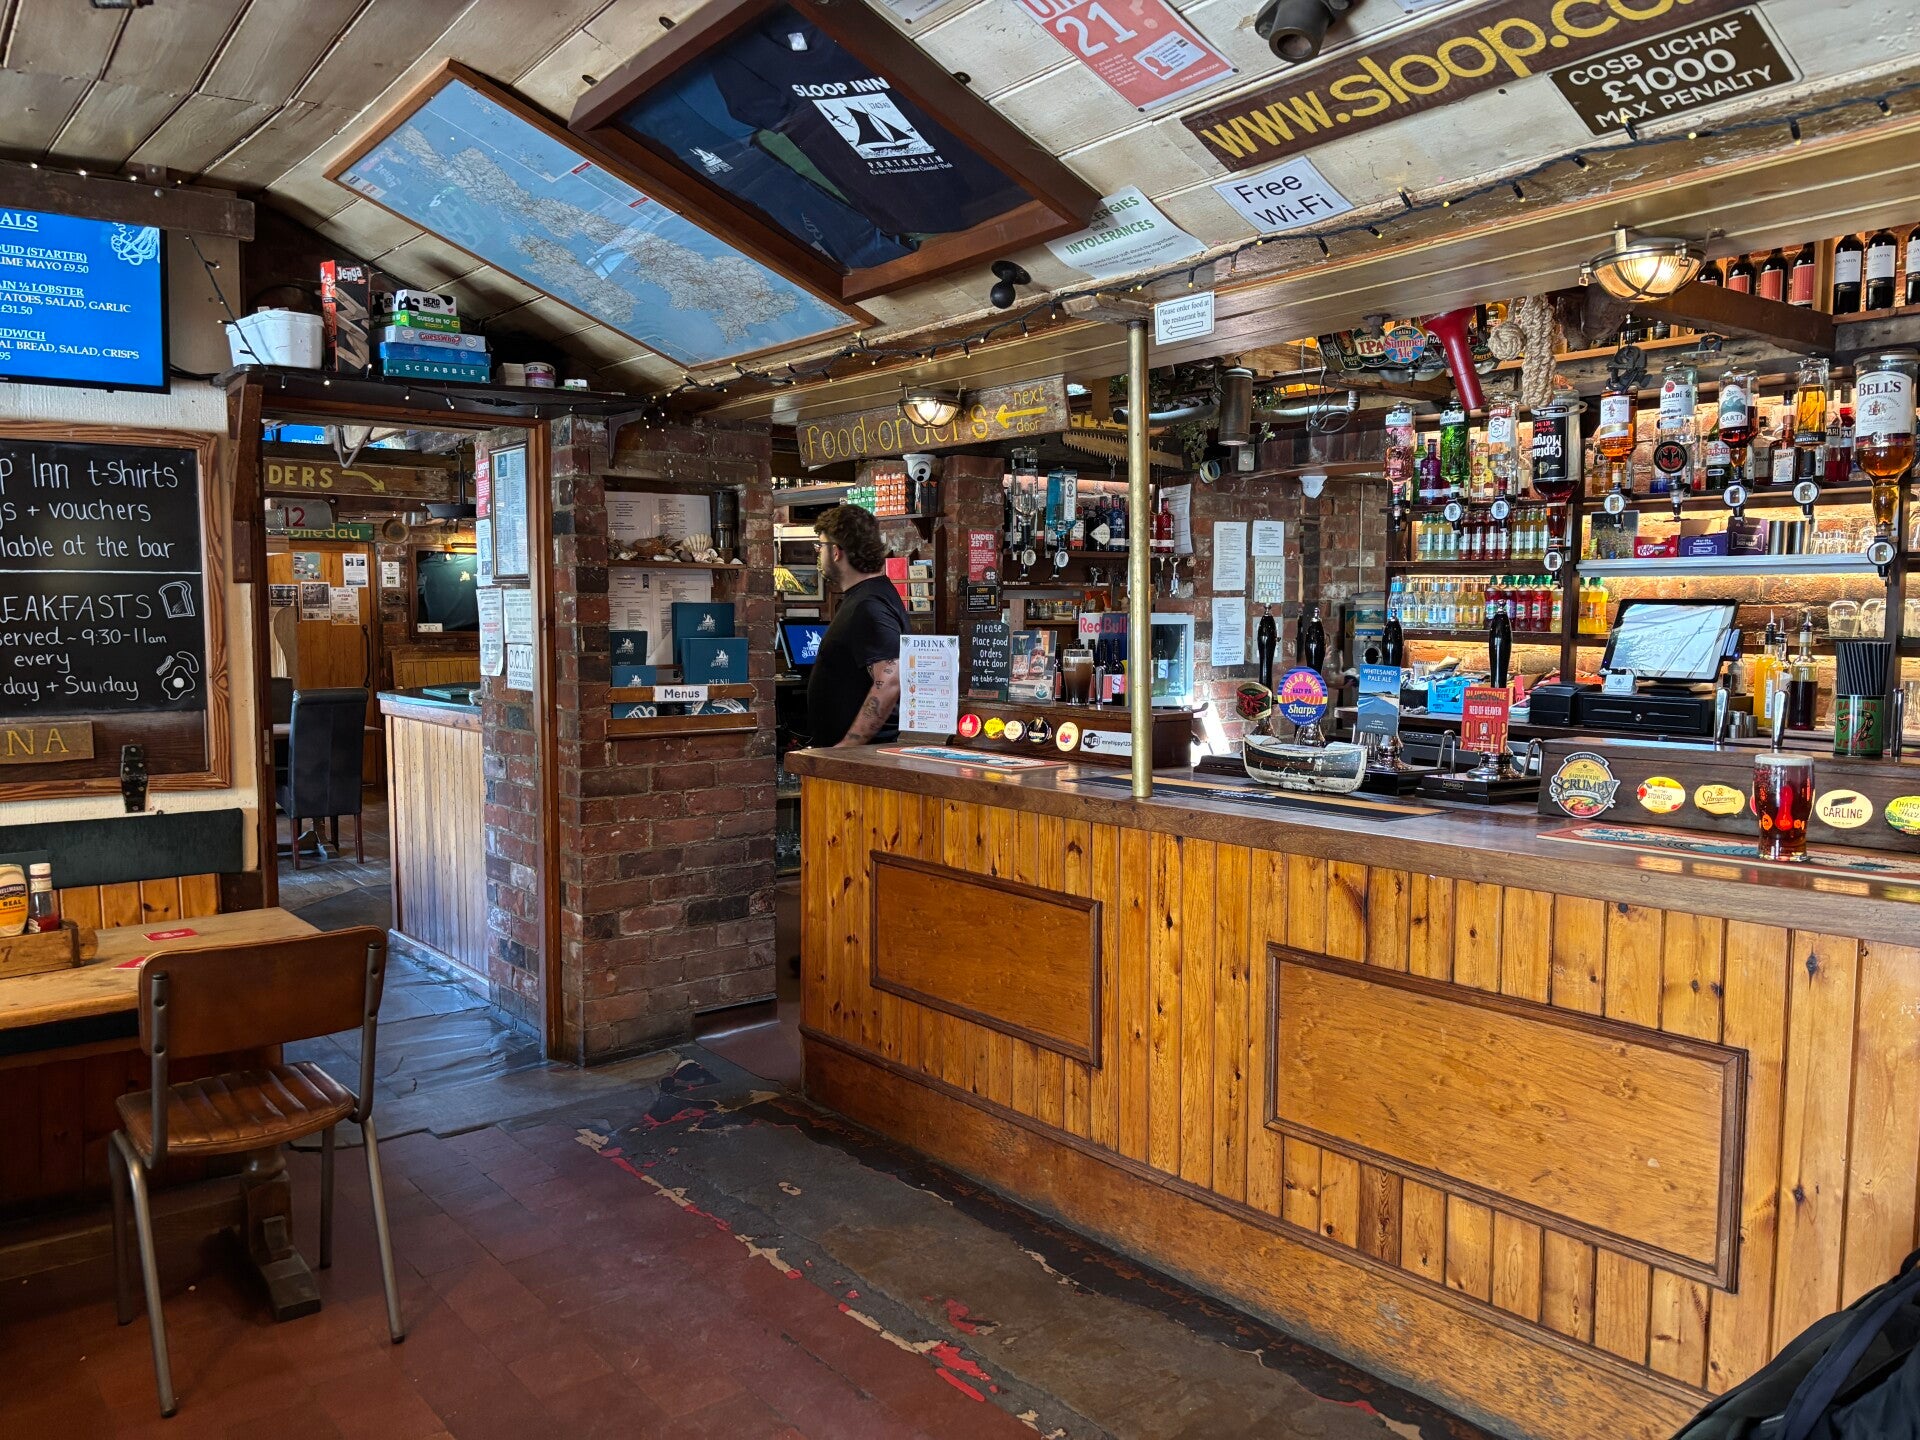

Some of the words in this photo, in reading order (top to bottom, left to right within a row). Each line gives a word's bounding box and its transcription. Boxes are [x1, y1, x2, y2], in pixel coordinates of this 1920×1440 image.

[1055, 2, 1137, 57] 21
[1568, 52, 1642, 86] COSB
[1648, 20, 1742, 62] UCHAF
[1602, 49, 1736, 104] £1000
[791, 82, 848, 98] SLOOP
[850, 76, 891, 93] INN
[1595, 100, 1655, 128] MAX
[1660, 64, 1773, 111] PENALTY
[1233, 173, 1303, 205] Free
[1254, 193, 1334, 226] Wi-Fi
[0, 212, 38, 229] ALS
[1090, 221, 1110, 232] and
[1065, 218, 1155, 255] INTOLERANCES
[0, 244, 25, 255] UID
[27, 247, 88, 263] (STARTER)
[26, 258, 62, 271] MAYO
[63, 263, 89, 274] £9.50
[336, 266, 363, 281] Jenga
[32, 284, 84, 297] LOBSTER
[45, 297, 87, 310] SALAD,
[88, 301, 132, 313] GARLIC
[422, 296, 440, 305] HERD
[1159, 308, 1175, 316] Please
[1176, 304, 1190, 313] order
[1191, 301, 1203, 309] food
[1, 304, 33, 316] £31.50
[1171, 312, 1196, 324] restaurant
[416, 315, 435, 323] GUESS
[16, 341, 57, 354] BREAD,
[59, 345, 100, 357] SALAD,
[102, 348, 140, 360] CRISPS
[1359, 341, 1385, 354] IPA
[1384, 338, 1425, 350] Summer
[1396, 346, 1413, 358] Ale
[405, 364, 476, 376] SCRABBLE
[1013, 385, 1045, 406] next
[1859, 381, 1902, 397] BELL'S
[1016, 418, 1040, 434] door
[807, 416, 868, 460] Food
[32, 453, 69, 489] Inn
[268, 465, 334, 488] DERS
[49, 499, 151, 522] vouchers
[284, 506, 306, 528] 12
[0, 535, 54, 557] lable
[63, 535, 86, 556] at
[96, 536, 130, 557] the
[138, 535, 176, 558] bar
[986, 571, 996, 580] 25
[1080, 616, 1102, 634] Red
[1104, 617, 1127, 634] Bull
[913, 639, 945, 648] DRINK
[972, 637, 990, 647] Place
[992, 638, 1008, 647] food
[14, 653, 71, 674] every
[972, 659, 990, 668] next
[991, 659, 1008, 669] door
[1363, 668, 1398, 677] WHITESANDS
[1284, 675, 1304, 694] SOLAR
[1306, 675, 1321, 694] WAVE
[664, 688, 700, 699] Menus
[1288, 704, 1316, 718] Sharp's
[1551, 776, 1618, 802] SCRUMPY
[1823, 806, 1863, 819] CARLING
